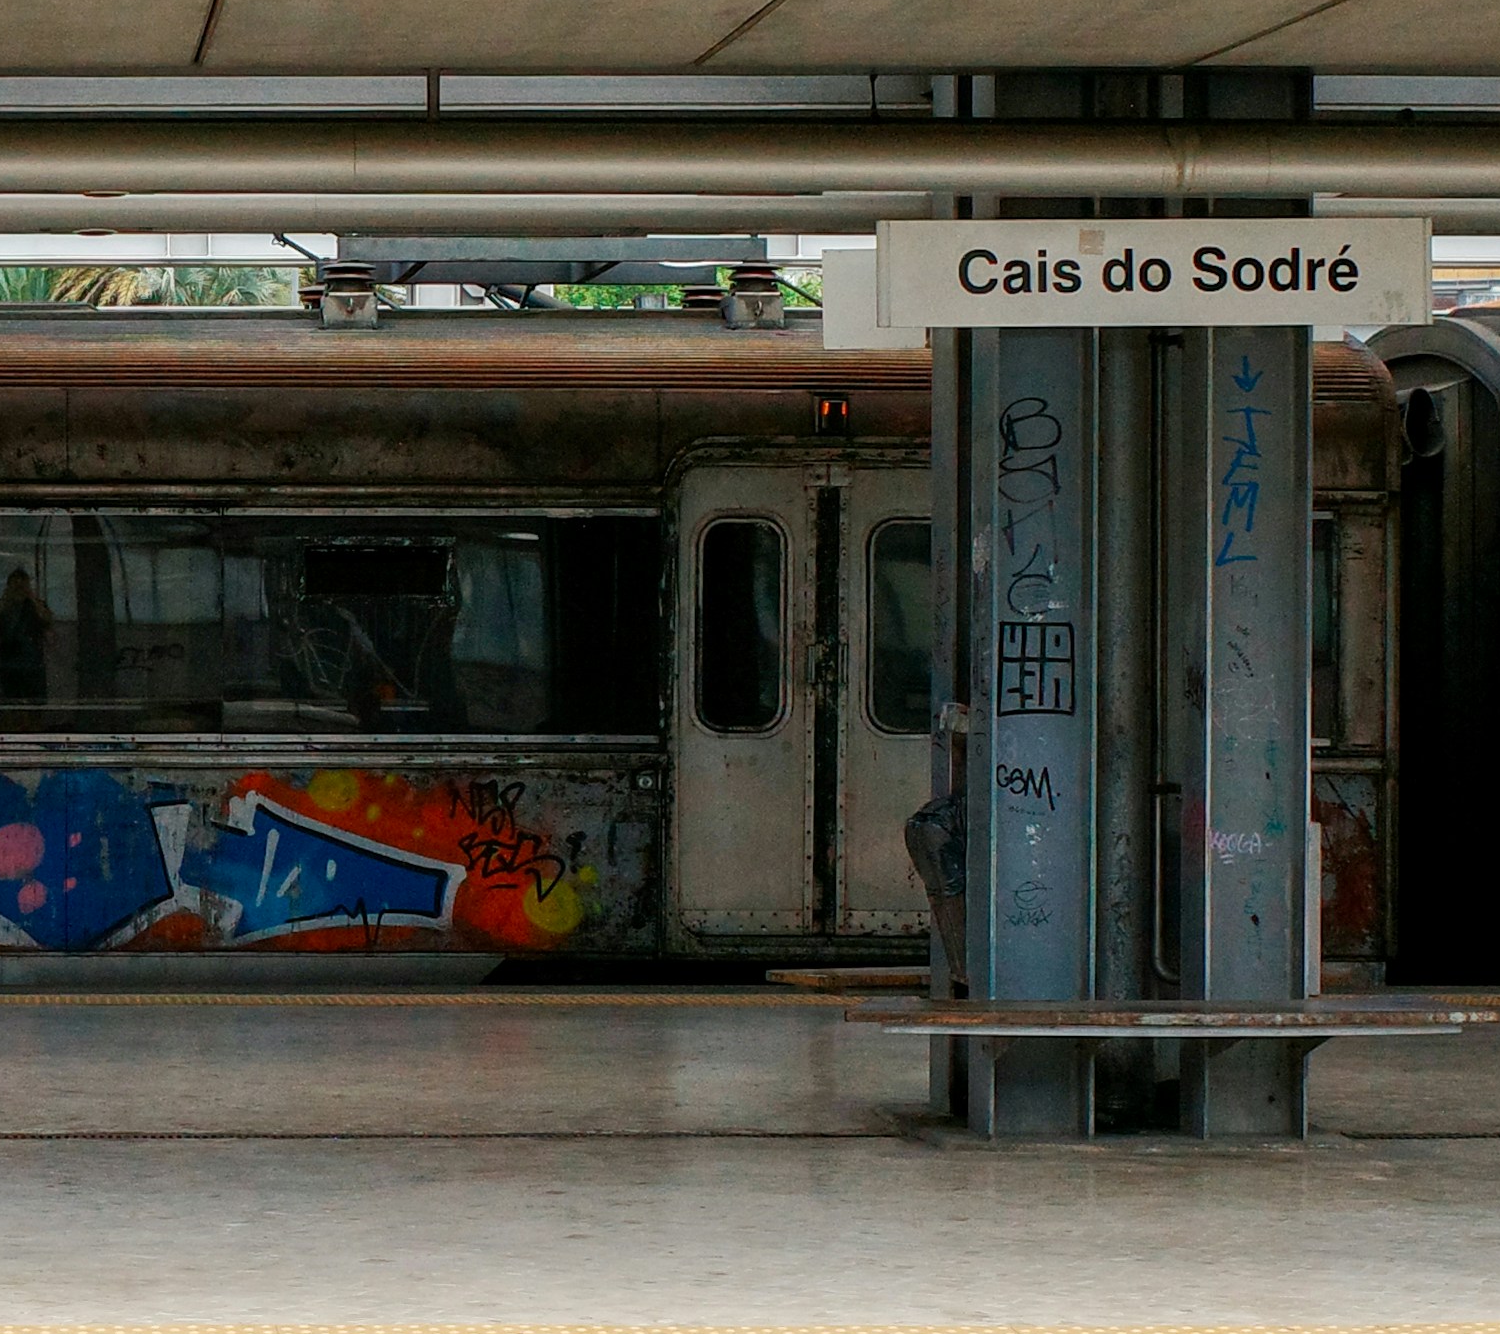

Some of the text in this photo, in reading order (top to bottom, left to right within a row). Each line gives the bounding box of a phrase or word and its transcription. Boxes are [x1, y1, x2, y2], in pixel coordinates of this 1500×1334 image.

[957, 244, 1360, 295] Cais do Sodré
